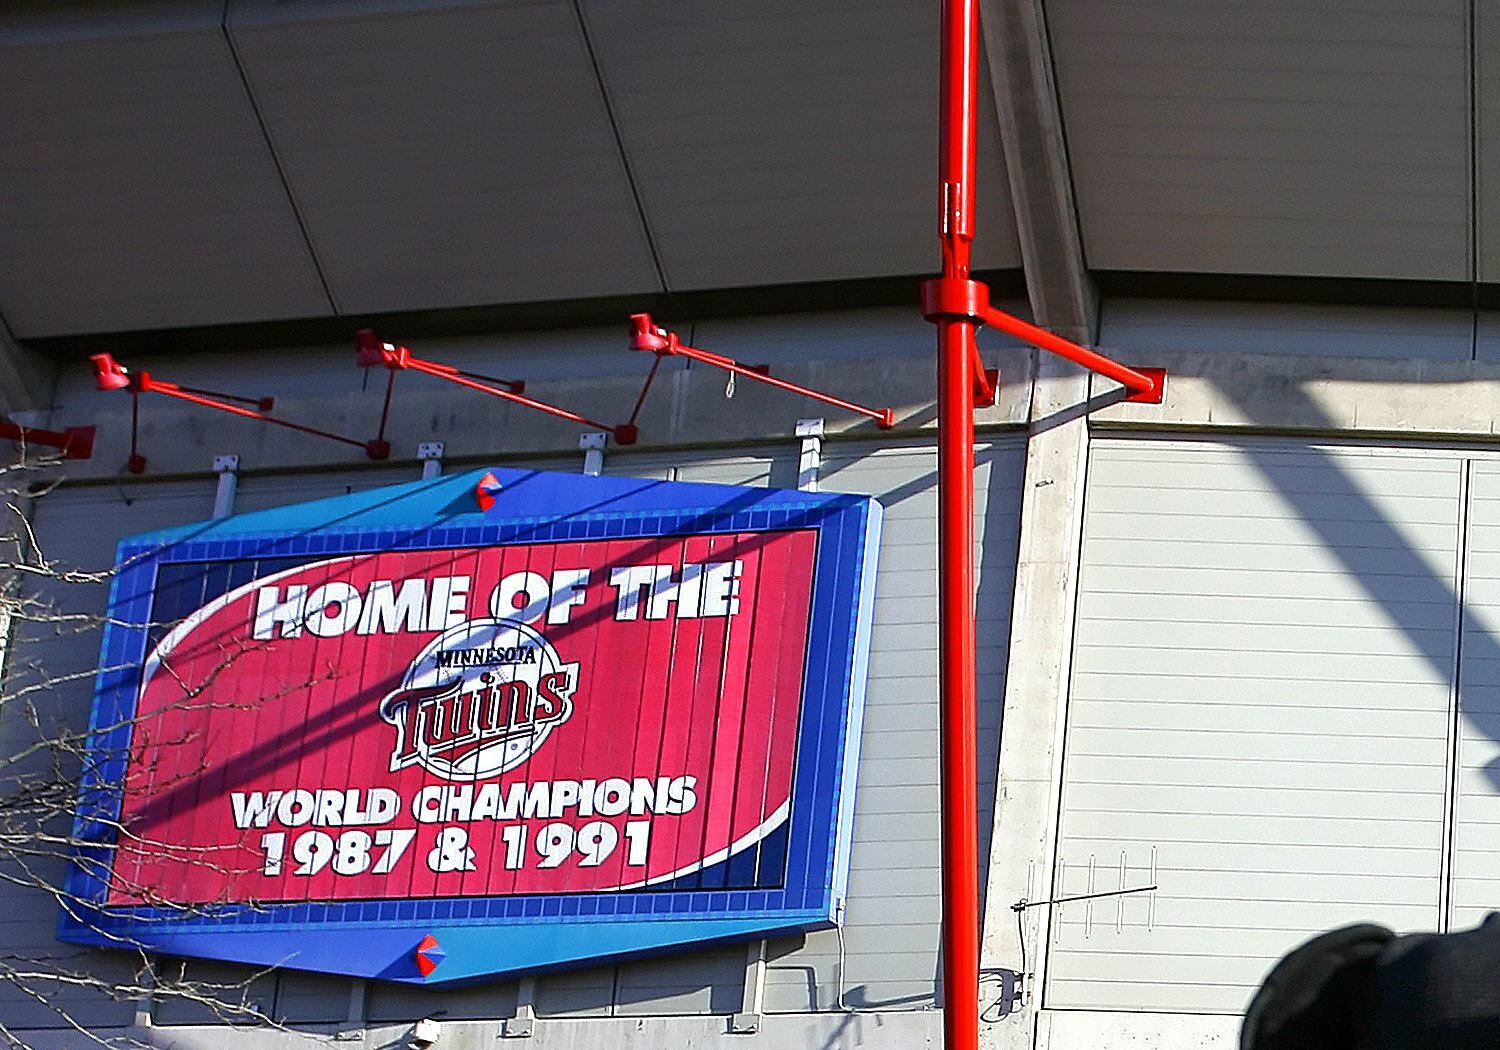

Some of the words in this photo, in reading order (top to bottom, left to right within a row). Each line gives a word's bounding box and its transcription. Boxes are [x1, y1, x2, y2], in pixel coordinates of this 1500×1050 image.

[253, 574, 470, 640] HOME
[489, 568, 591, 625] OF
[609, 559, 744, 622] THE
[434, 645, 537, 669] MINNESOTA
[383, 664, 574, 762] Twins
[231, 787, 400, 829] WORLD
[412, 775, 697, 823] CHAMPIONS
[260, 829, 416, 876] 1987
[428, 826, 476, 873] &
[502, 820, 651, 870] 1991
